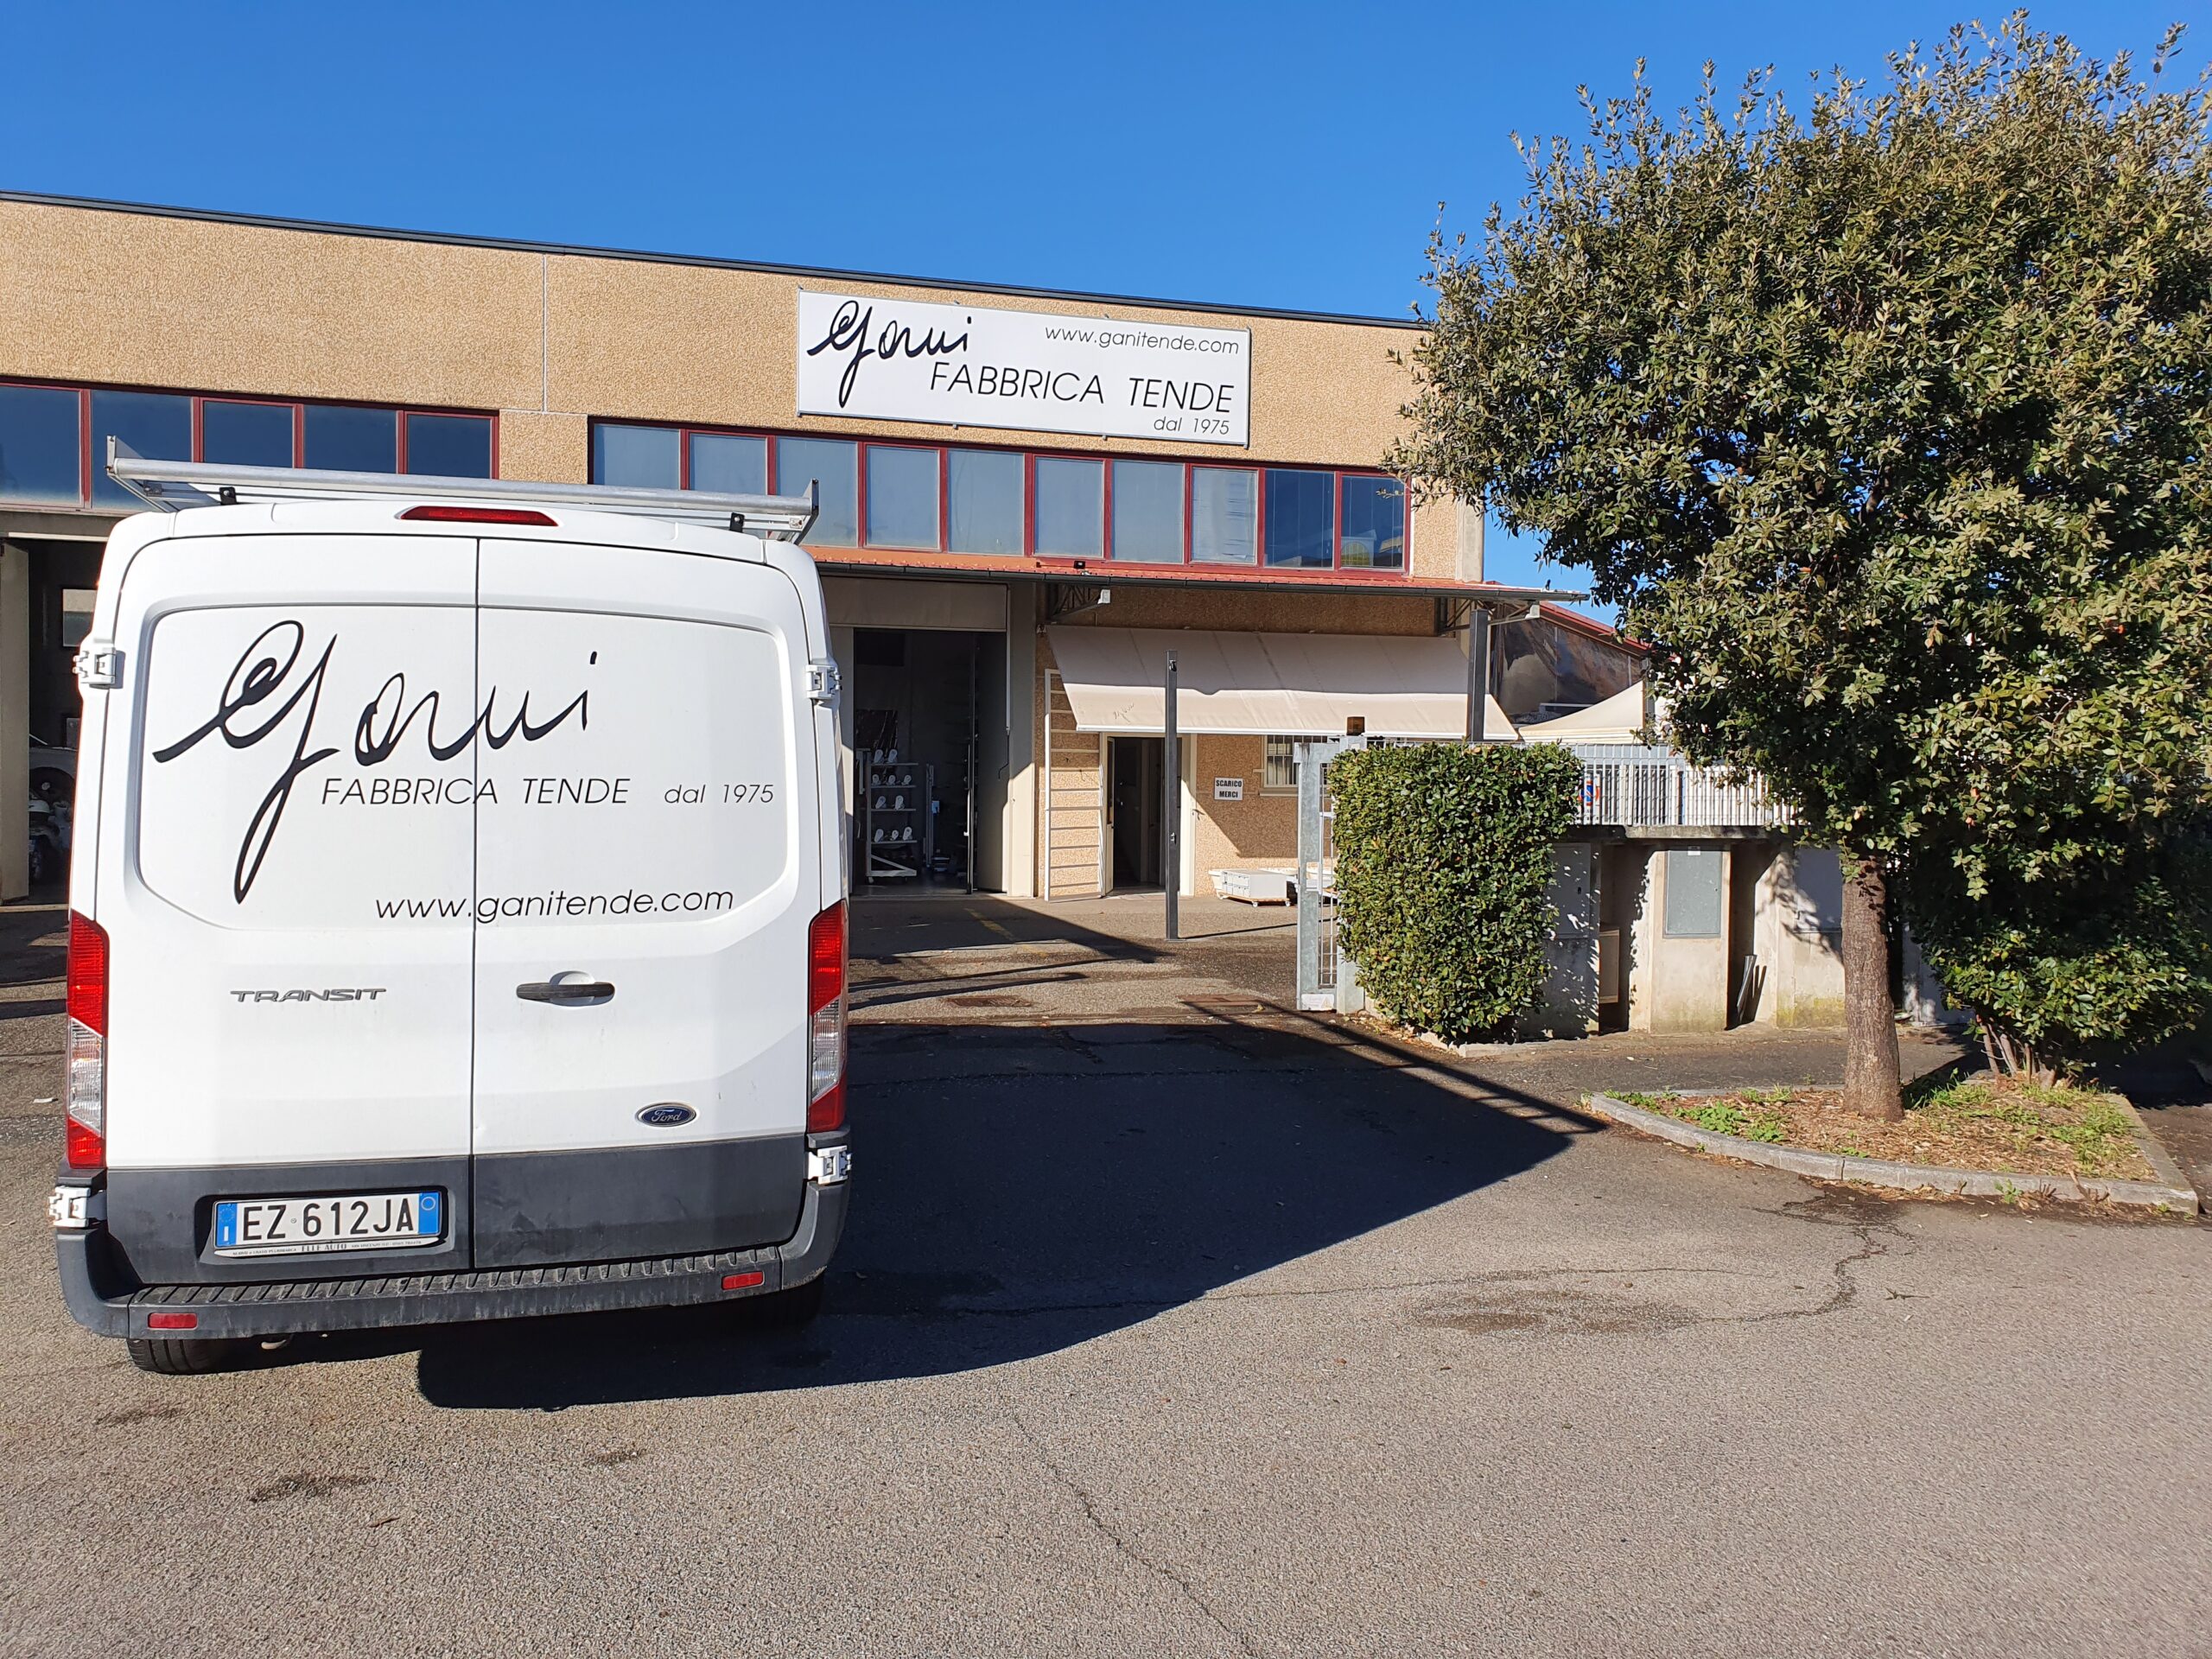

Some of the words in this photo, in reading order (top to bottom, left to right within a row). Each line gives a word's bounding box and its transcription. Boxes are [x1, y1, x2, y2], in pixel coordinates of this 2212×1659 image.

[1045, 327, 1239, 354] www.ganitende.com
[930, 361, 1104, 404] FABBRICA
[1128, 377, 1235, 414] TENDE
[1153, 416, 1183, 432] dal
[1192, 417, 1230, 435] 1975
[321, 778, 499, 805] FABBRICA
[522, 778, 631, 804] TENDE
[664, 784, 706, 804] dal
[722, 784, 774, 804] 1975
[1216, 779, 1243, 788] SCARICO
[1218, 790, 1238, 798] MERCI
[375, 888, 734, 925] www.ganitende.com
[230, 988, 387, 1003] TRANSIT
[651, 1108, 683, 1122] Ford
